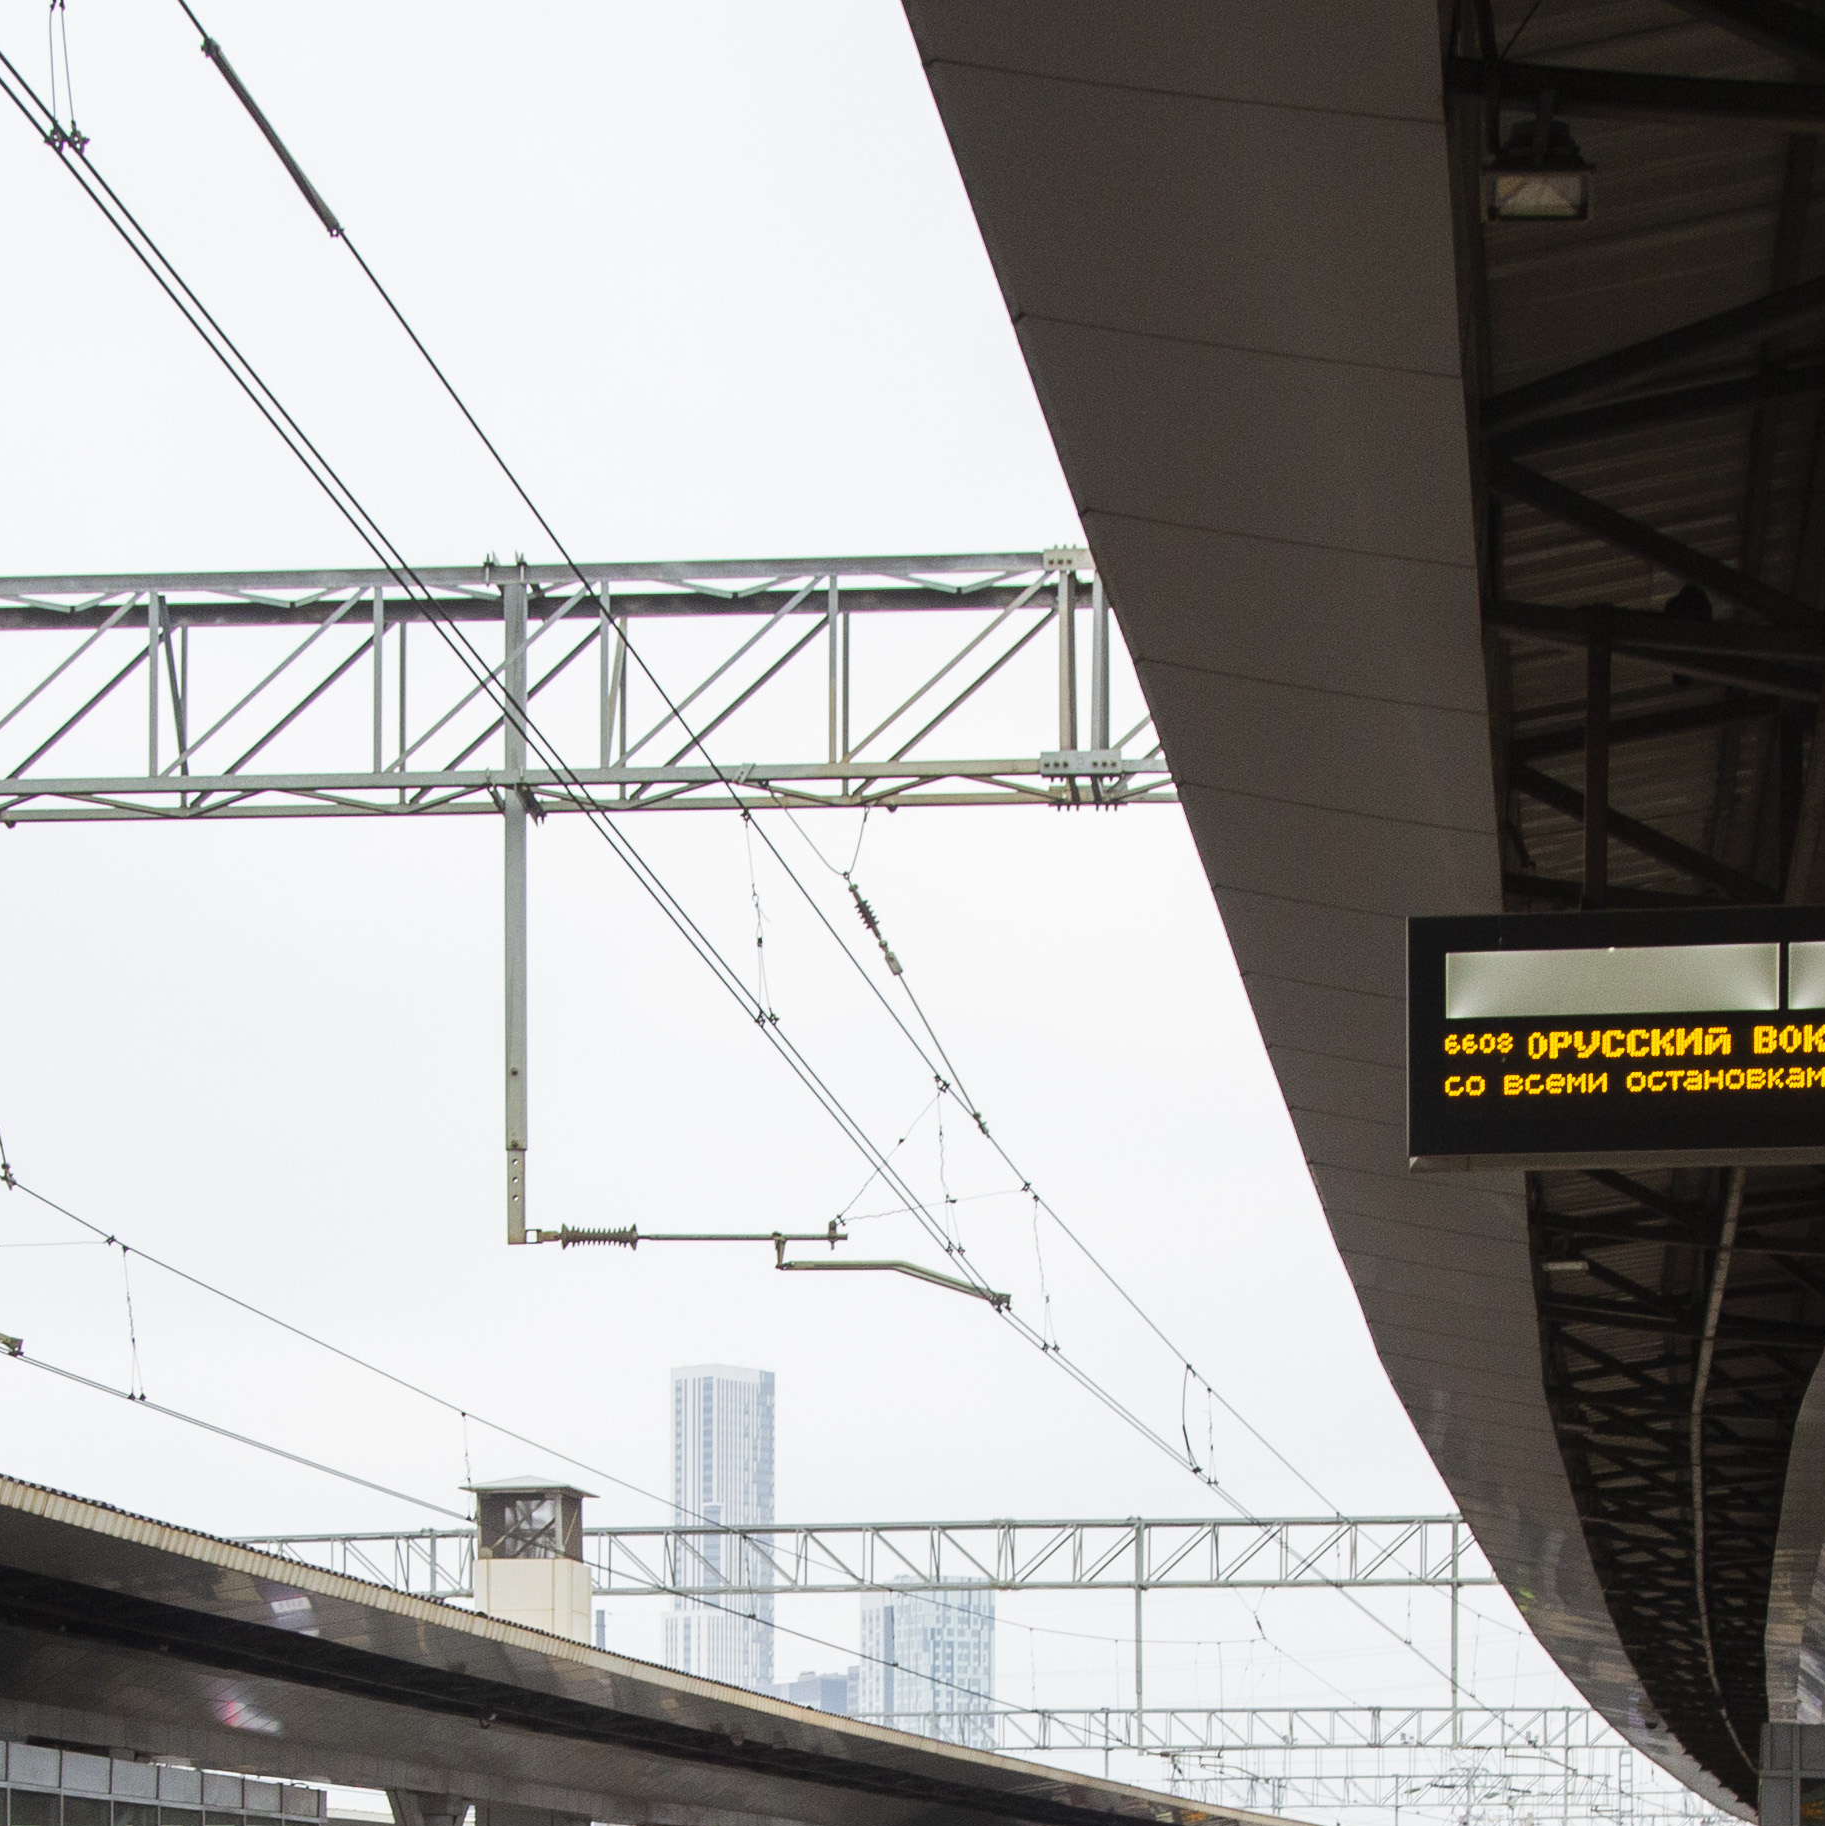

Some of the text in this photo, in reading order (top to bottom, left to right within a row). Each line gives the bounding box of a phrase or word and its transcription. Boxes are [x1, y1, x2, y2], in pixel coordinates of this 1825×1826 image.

[1444, 1032, 1514, 1056] 6608
[1444, 1075, 1486, 1097] со
[1503, 1072, 1609, 1096] всеми
